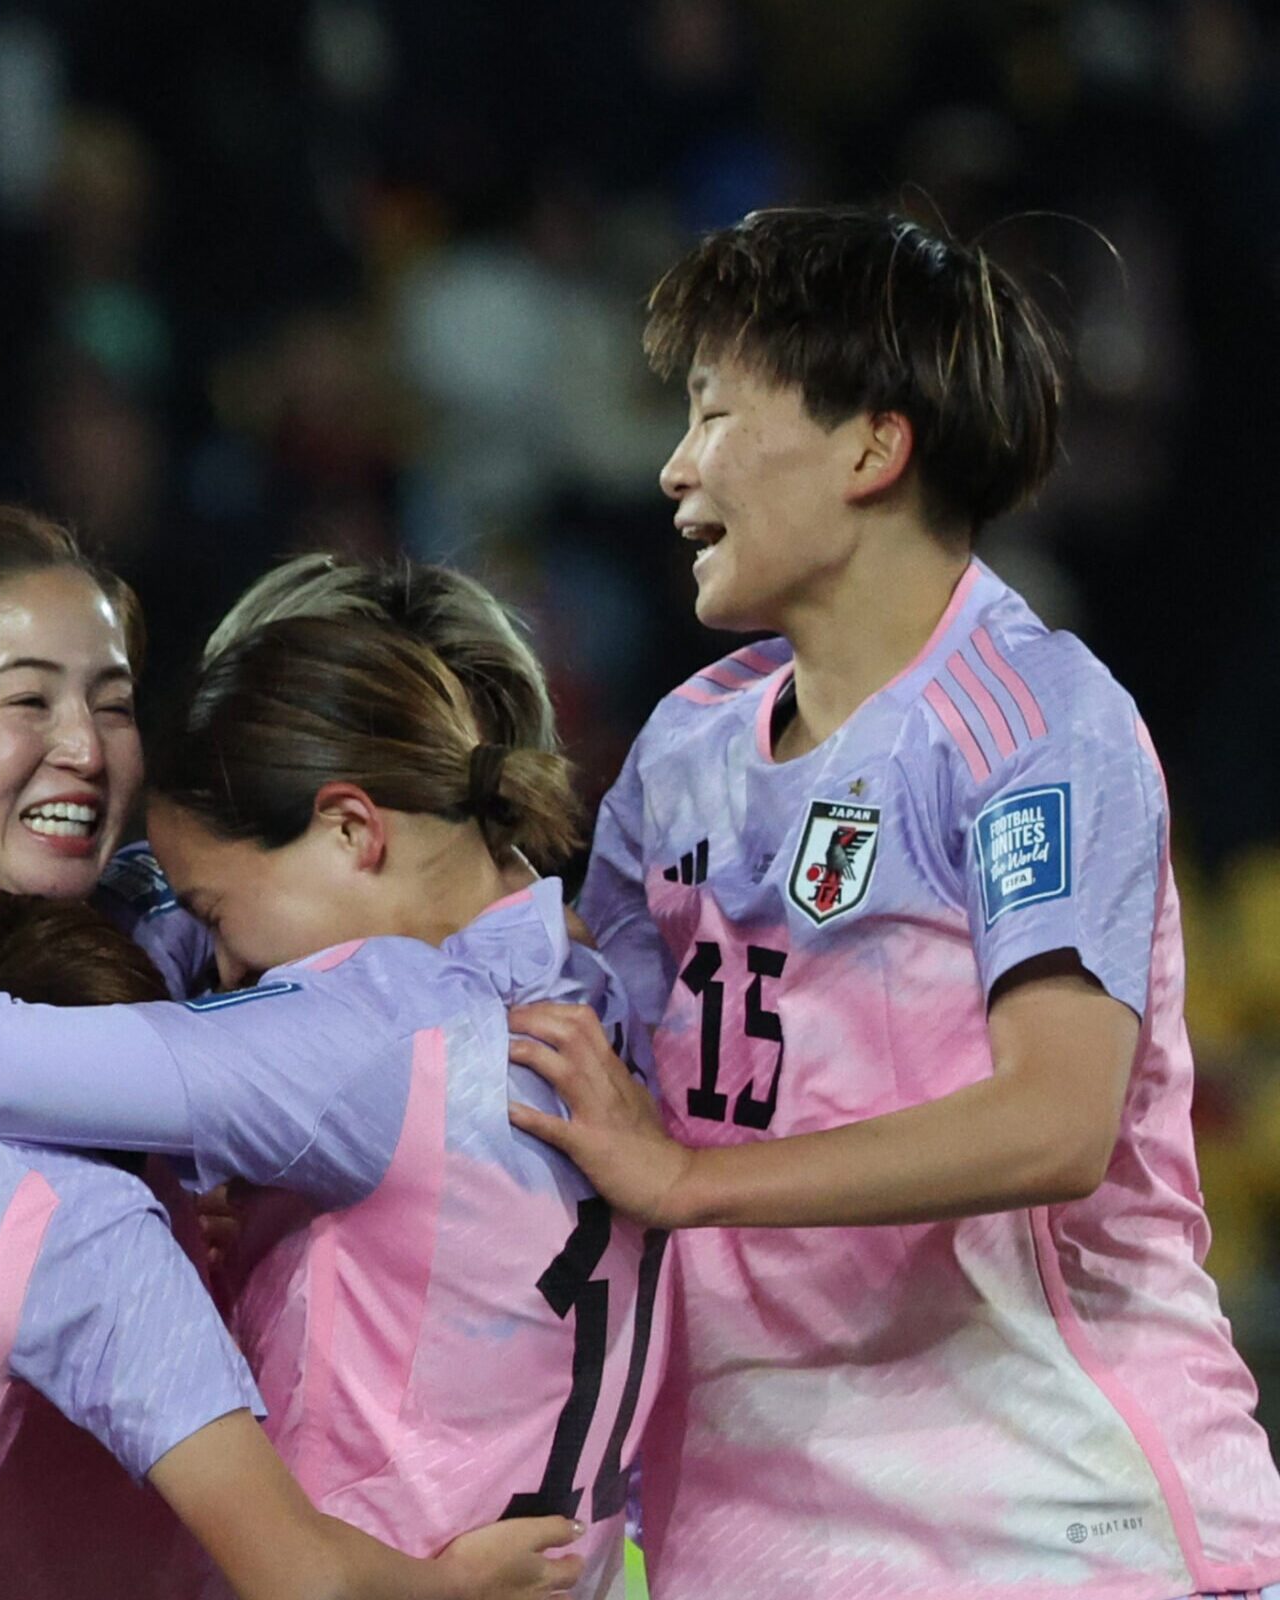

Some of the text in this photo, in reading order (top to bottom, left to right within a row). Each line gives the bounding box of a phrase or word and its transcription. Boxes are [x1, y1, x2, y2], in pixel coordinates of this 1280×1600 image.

[828, 806, 872, 821] JAPAN
[990, 805, 1045, 839] FOOTBALL
[991, 822, 1046, 862] UNITES
[1008, 842, 1050, 872] World
[807, 884, 842, 904] JFA
[1005, 873, 1028, 890] FIFA
[680, 940, 789, 1131] 15
